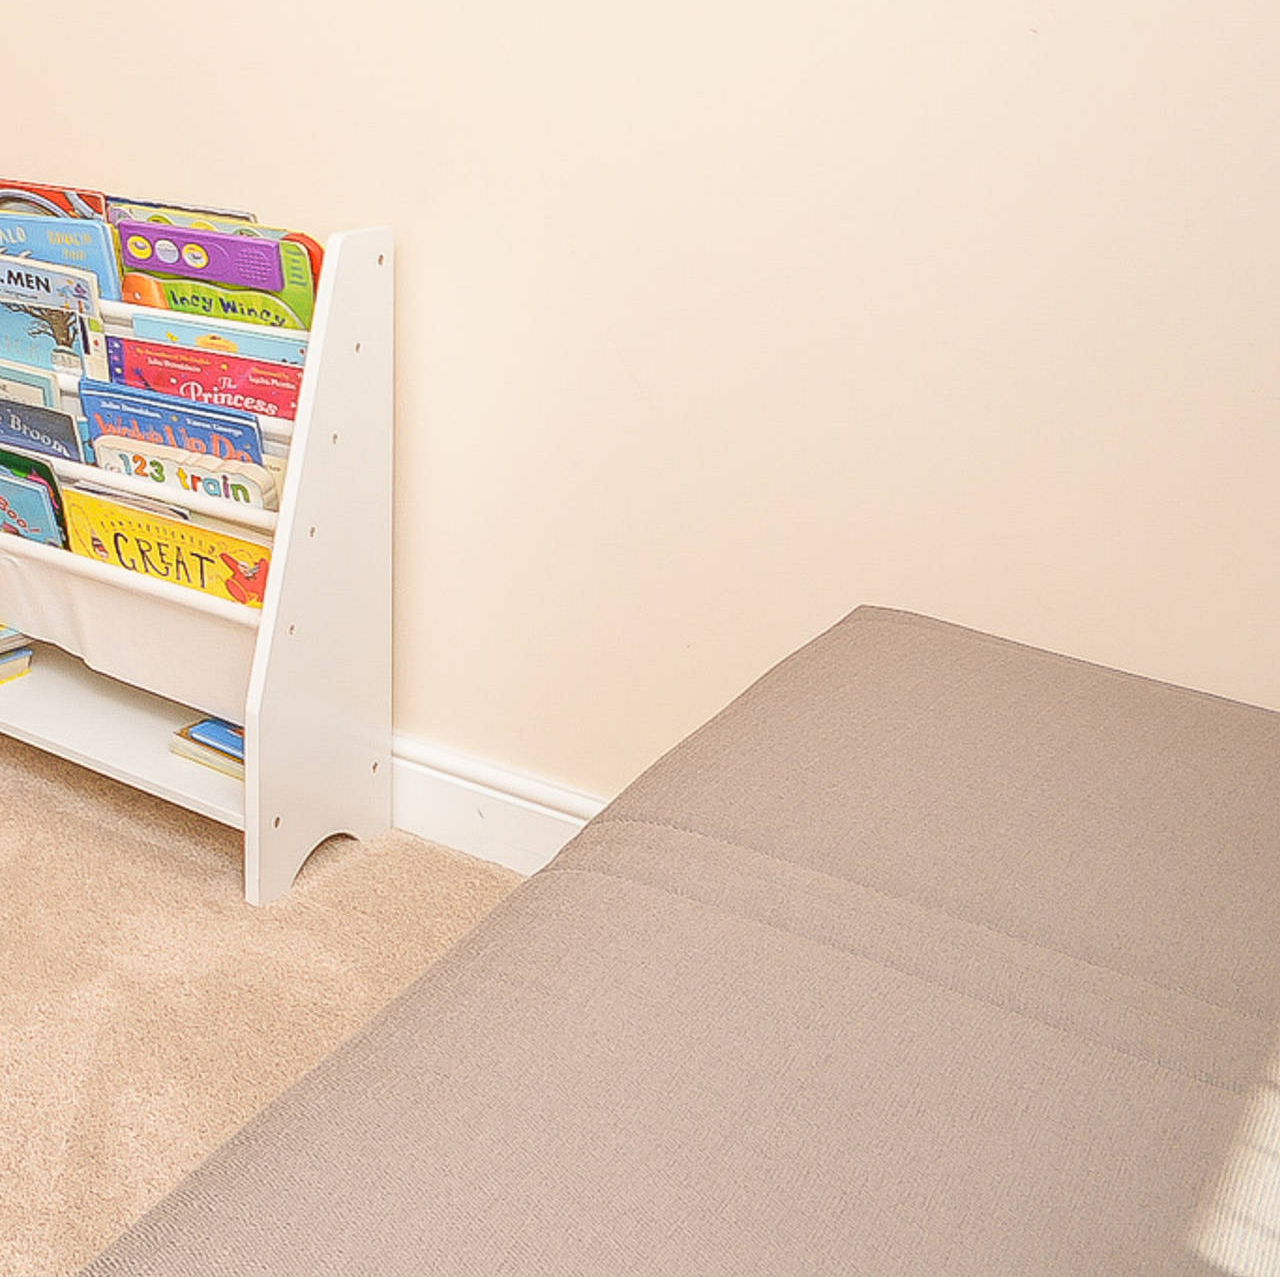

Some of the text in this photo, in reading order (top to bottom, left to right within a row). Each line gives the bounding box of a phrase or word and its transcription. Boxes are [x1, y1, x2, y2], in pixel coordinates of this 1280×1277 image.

[6, 269, 52, 294] MEN
[169, 289, 286, 328] Incy Wincy
[179, 380, 280, 417] Princess
[8, 414, 72, 458] Broom
[118, 452, 252, 504] 123 train
[112, 531, 216, 589] GREAT
